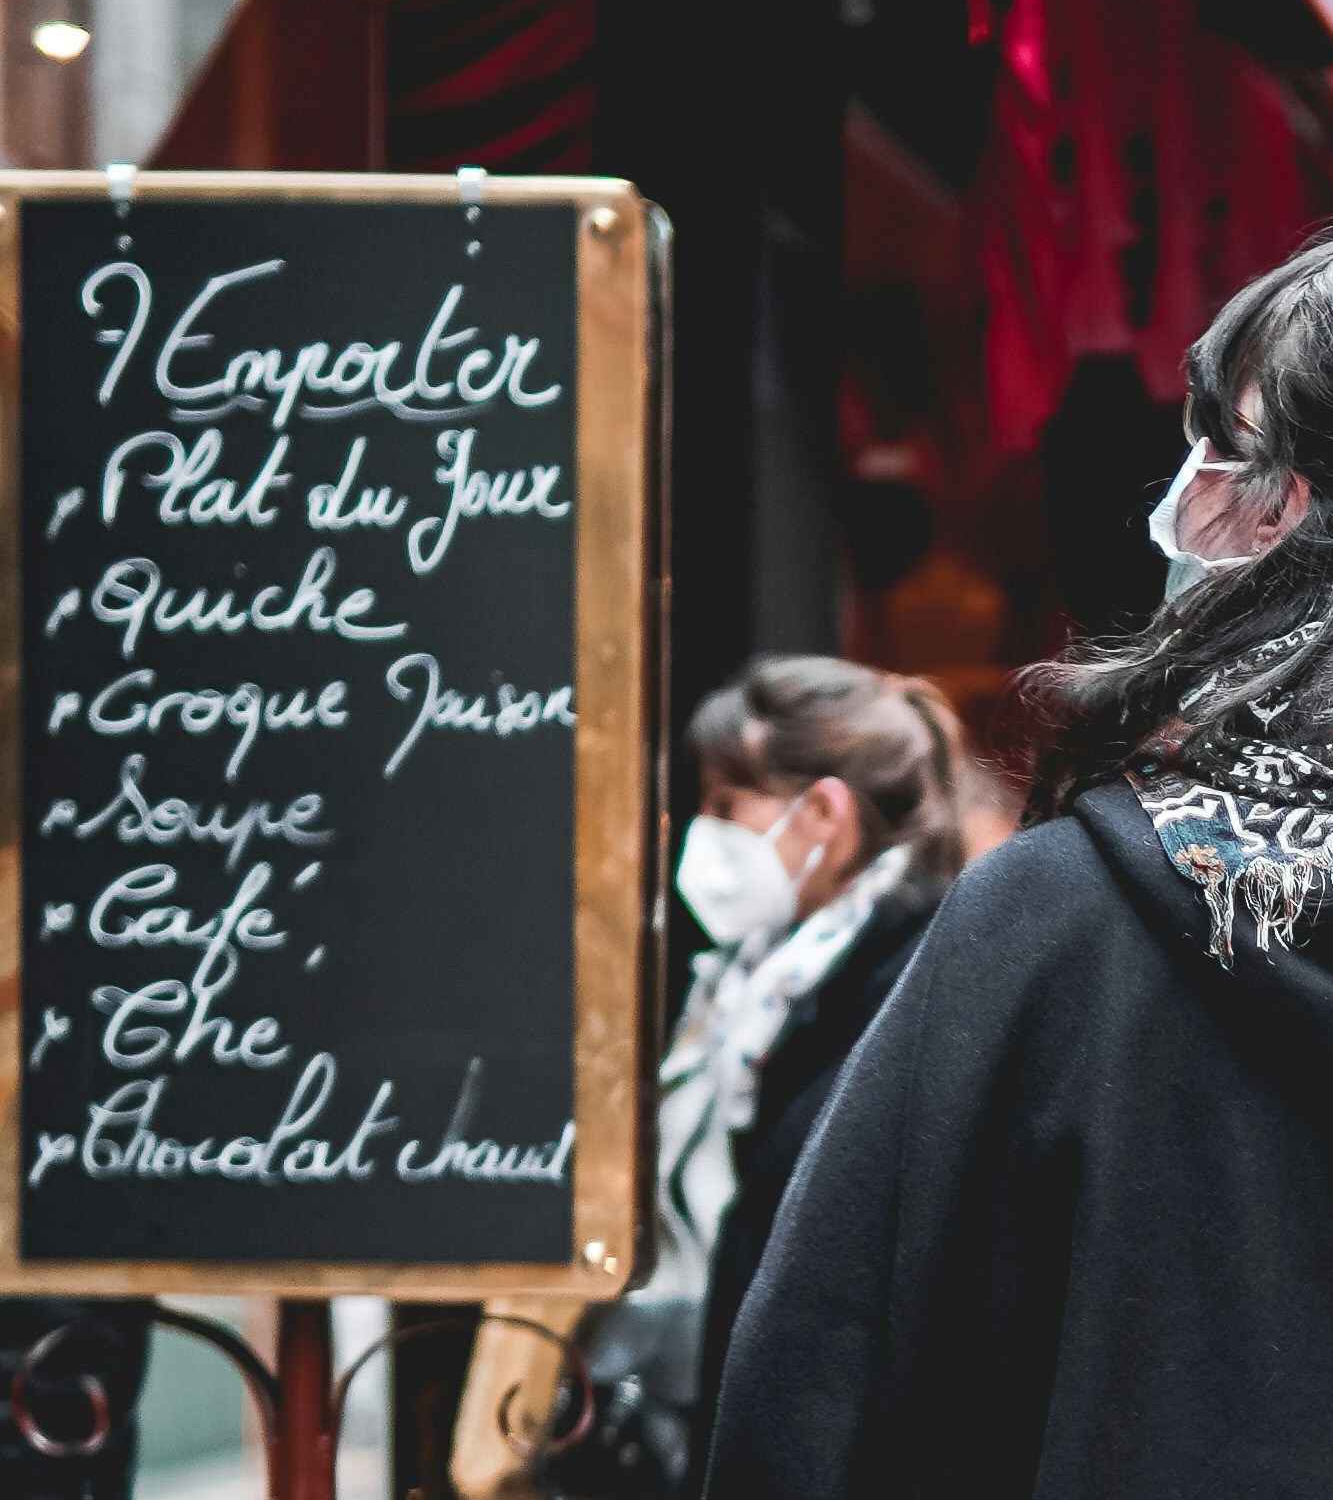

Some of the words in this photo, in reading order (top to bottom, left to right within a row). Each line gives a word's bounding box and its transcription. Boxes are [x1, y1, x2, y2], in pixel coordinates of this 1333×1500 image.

[156, 258, 562, 428] Emporter
[103, 430, 294, 527] Plat
[307, 436, 408, 528] du
[408, 428, 572, 576] Jour
[92, 546, 408, 658] Quiche
[88, 668, 350, 780] Croque
[82, 1050, 398, 1184] Chocolat
